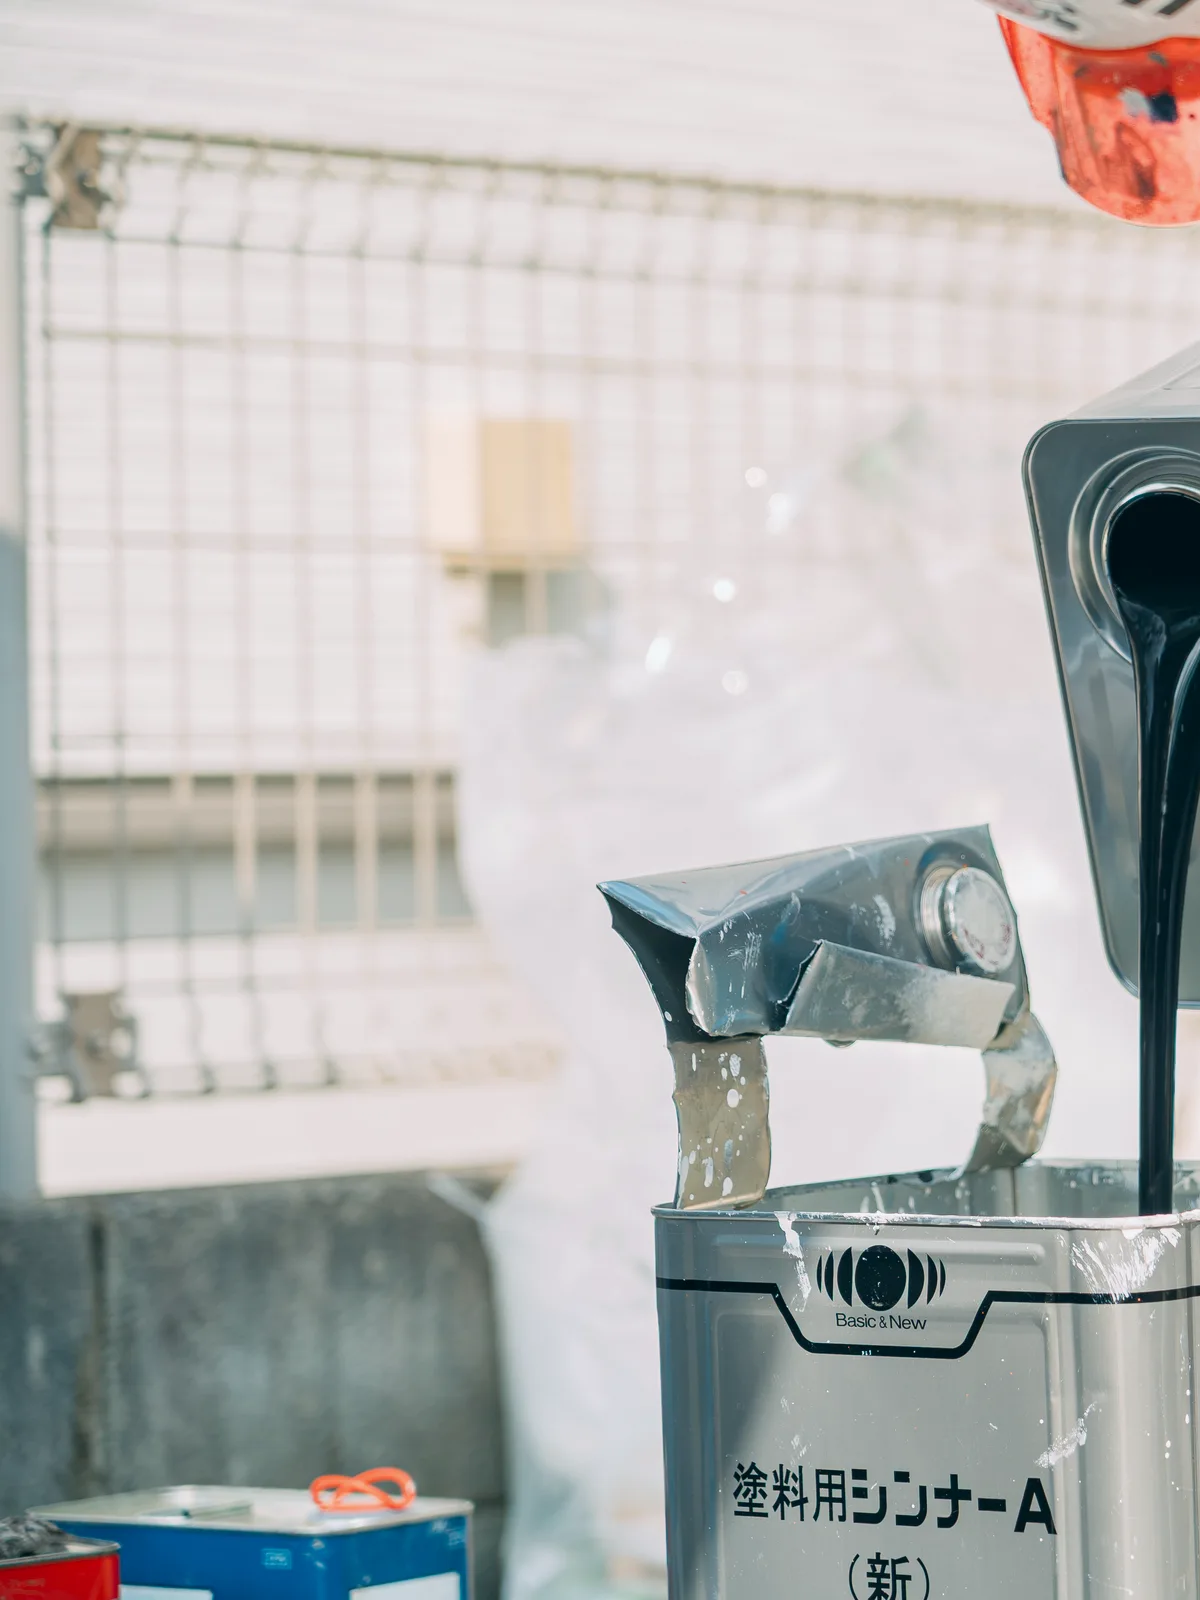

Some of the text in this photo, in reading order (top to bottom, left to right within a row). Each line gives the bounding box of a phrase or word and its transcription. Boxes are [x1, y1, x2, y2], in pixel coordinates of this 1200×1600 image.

[835, 1312, 927, 1331] Basic & New
[732, 1462, 1057, 1535] 塗料用シンナーA
[848, 1552, 930, 1600] （新）
